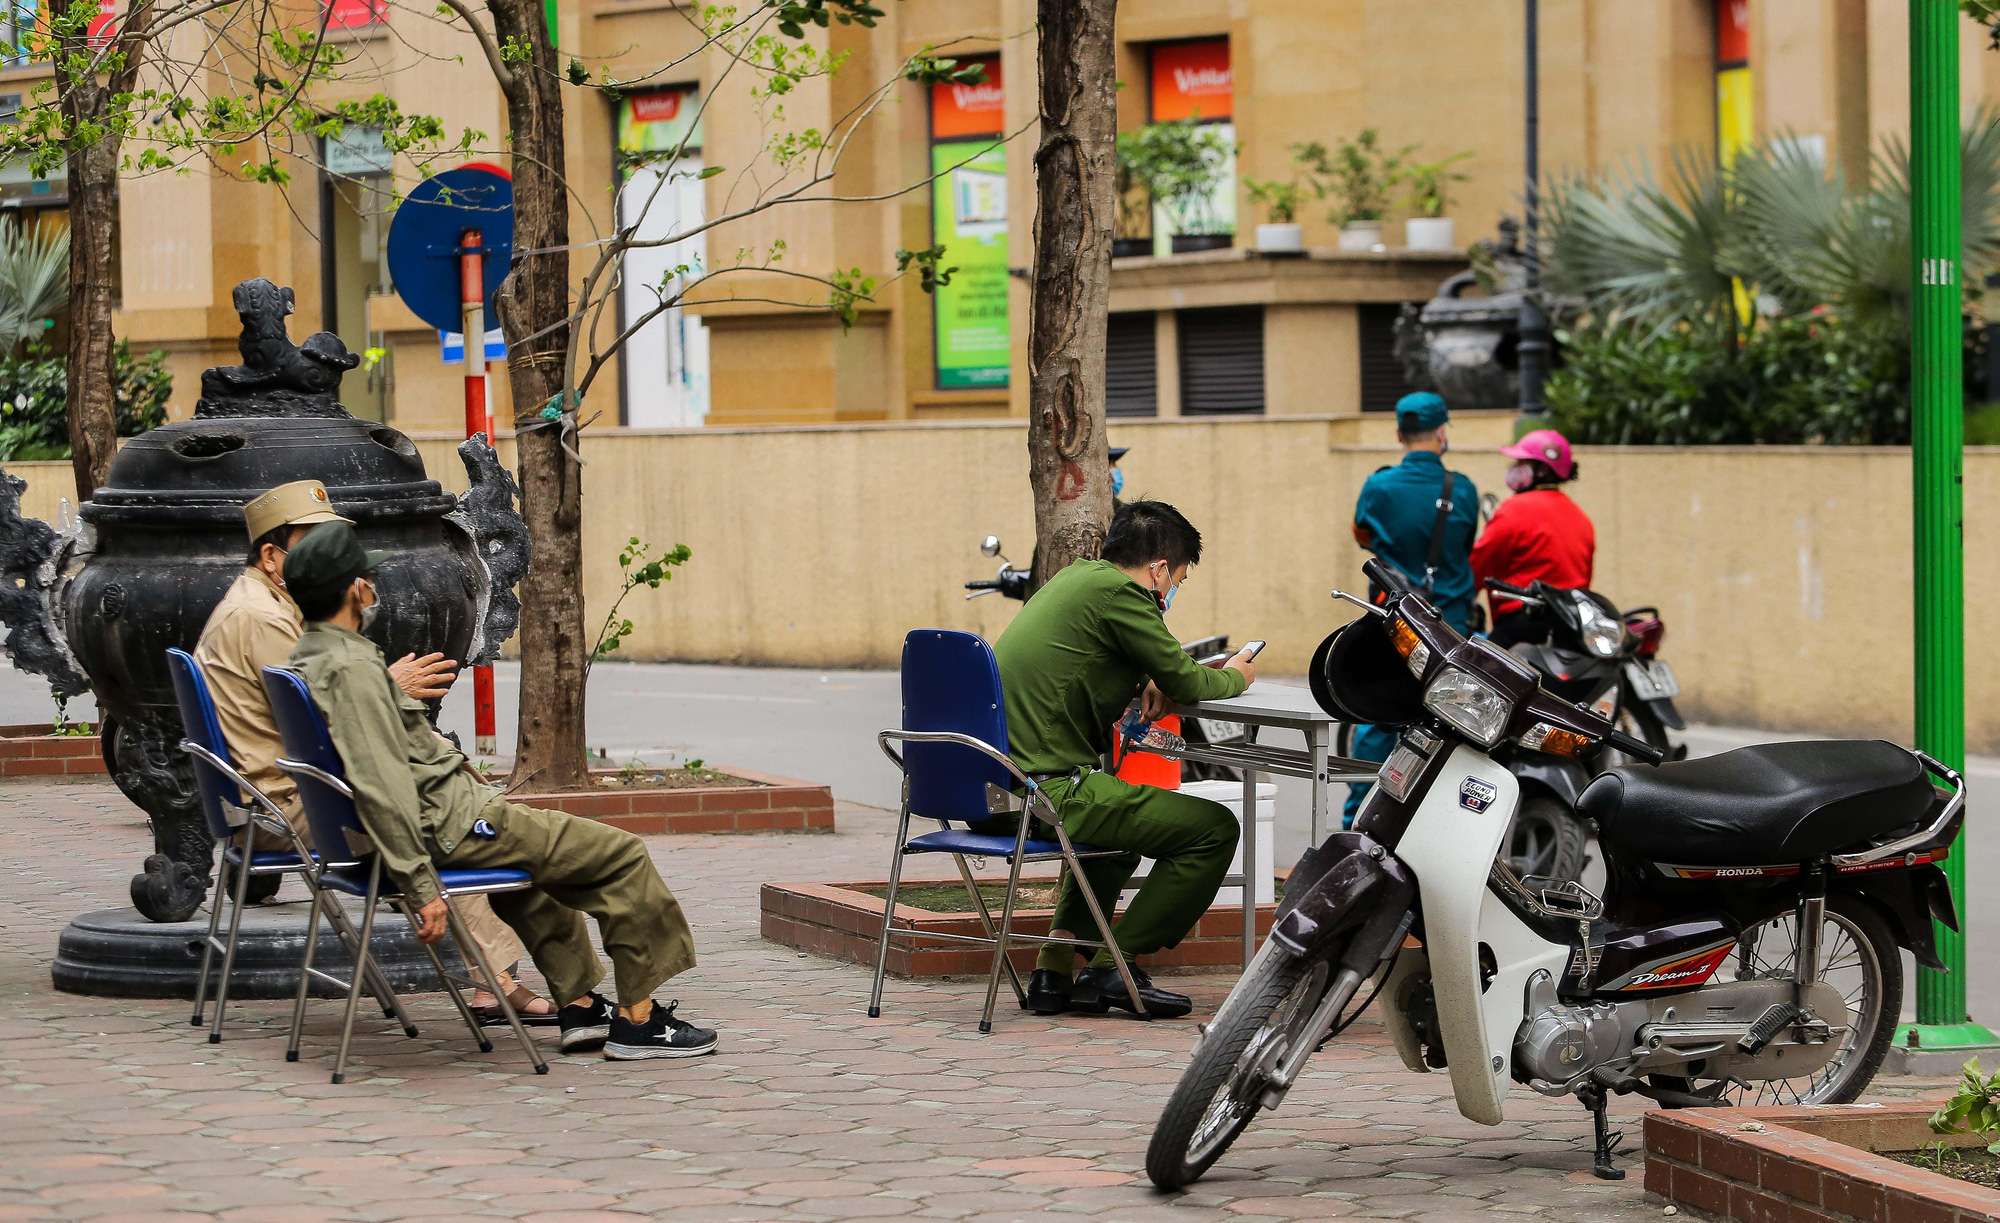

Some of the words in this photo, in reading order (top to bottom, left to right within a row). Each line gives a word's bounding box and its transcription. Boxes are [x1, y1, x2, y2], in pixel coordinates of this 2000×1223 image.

[1464, 788, 1491, 801] POWER
[1715, 868, 1763, 876] HONDA
[1631, 970, 1697, 985] Dream
